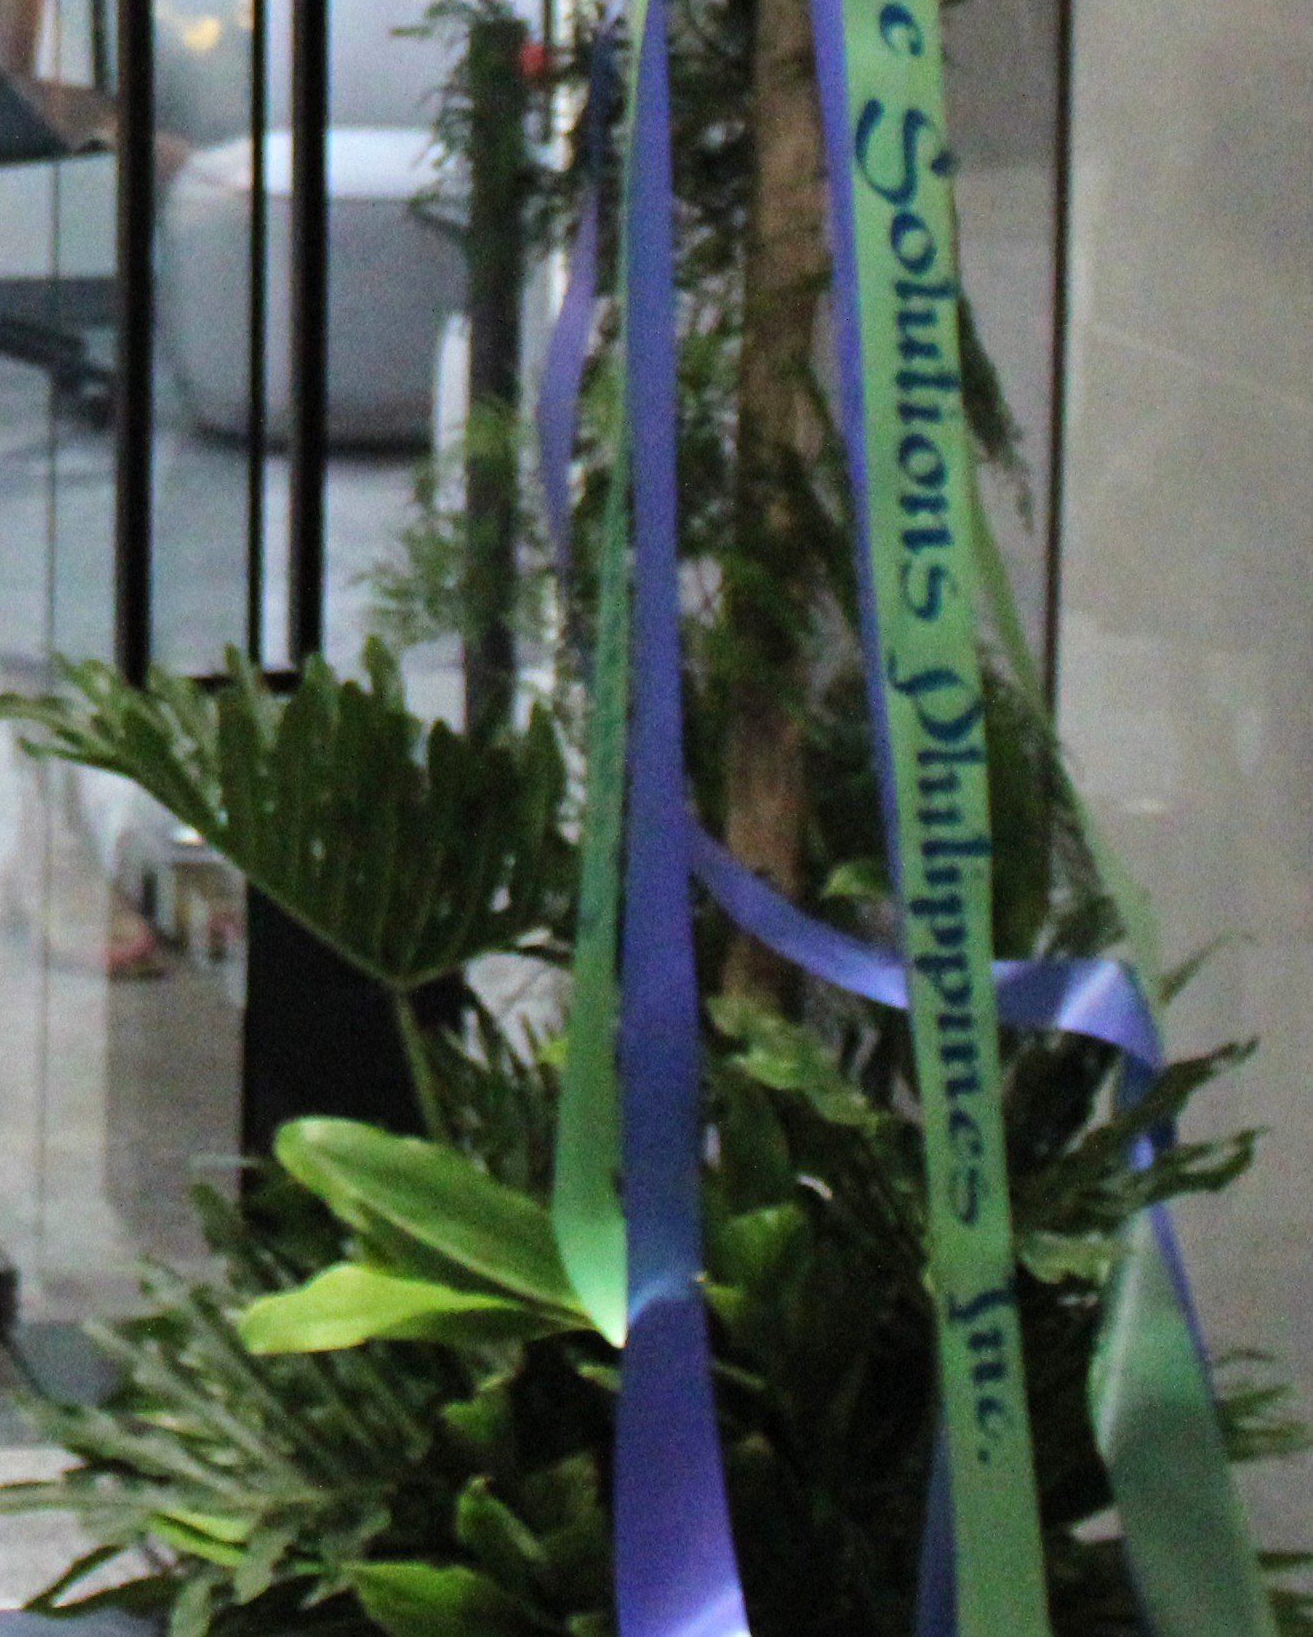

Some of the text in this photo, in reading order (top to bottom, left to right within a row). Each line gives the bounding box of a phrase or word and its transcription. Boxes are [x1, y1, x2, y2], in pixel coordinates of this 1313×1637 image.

[855, 98, 963, 622] Solutions
[887, 648, 993, 1227] Philippines
[946, 1277, 1017, 1465] Inc.
